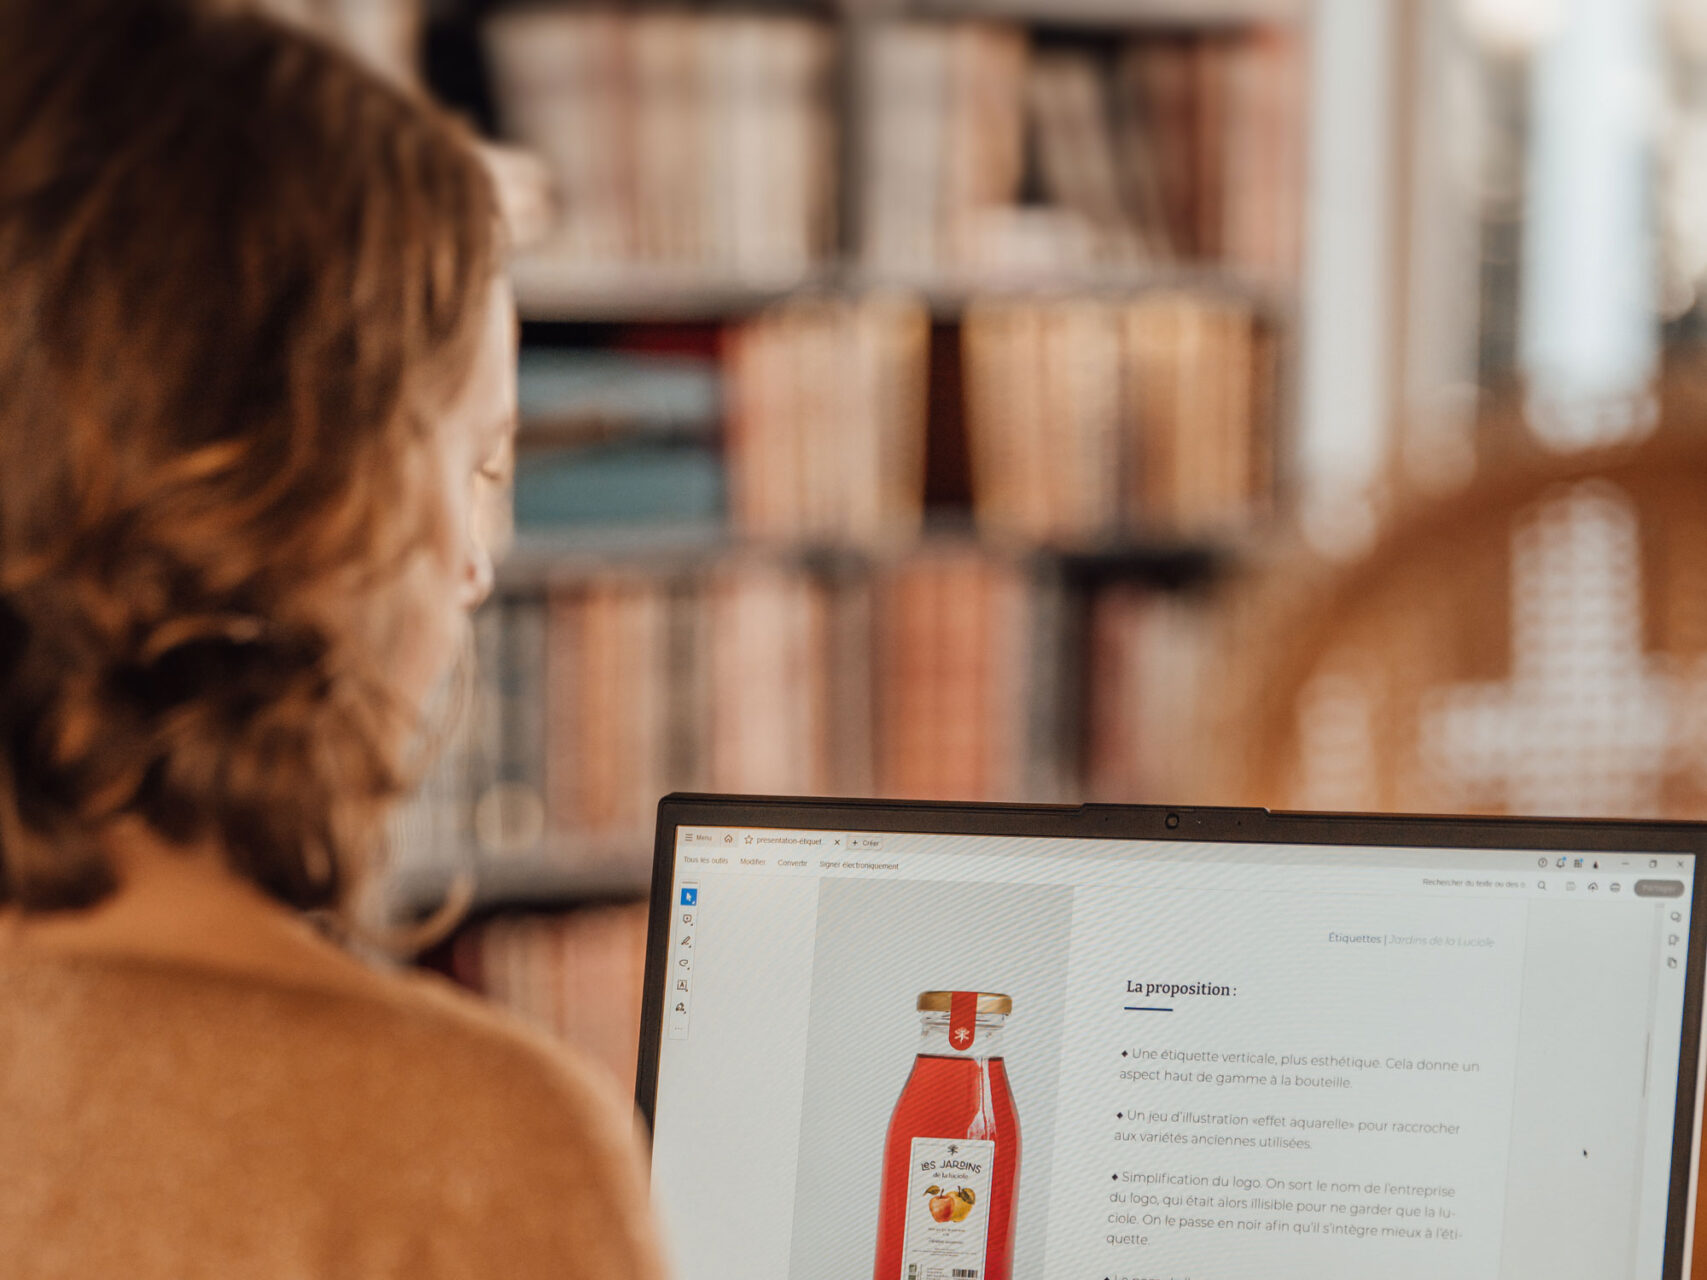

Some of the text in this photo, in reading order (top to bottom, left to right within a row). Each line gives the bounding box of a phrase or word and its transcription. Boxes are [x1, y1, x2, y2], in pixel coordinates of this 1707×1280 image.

[684, 856, 698, 864] Tous
[1422, 878, 1463, 888] Rechercher
[1328, 931, 1381, 944] Étiquettes
[1388, 934, 1427, 946] Jardins
[1429, 935, 1442, 946] de
[1445, 936, 1456, 946] la
[1457, 937, 1495, 948] Luciole
[1127, 980, 1143, 993] La
[1132, 1048, 1158, 1060] Une
[1160, 1049, 1219, 1063] étiquette
[1221, 1052, 1278, 1065] verticale,
[1281, 1054, 1308, 1068] plus
[1385, 1058, 1414, 1070] Cela
[1417, 1059, 1459, 1072] donne
[1462, 1062, 1480, 1072] un
[1119, 1069, 1352, 1089] aspect haut de gamme à la bouteille.
[1127, 1110, 1145, 1121] Un
[1147, 1111, 1168, 1124] jeu
[1171, 1111, 1249, 1126] d'illustration
[1358, 1121, 1388, 1133] pour
[1392, 1122, 1460, 1135] raccrocher
[1114, 1131, 1312, 1150] aux variétés anciennes utilisées.
[940, 1160, 982, 1174] JARDINS
[1121, 1171, 1209, 1187] Simplification
[1212, 1175, 1229, 1187] du
[1266, 1177, 1286, 1190] On
[1288, 1180, 1313, 1191] sort
[1316, 1180, 1328, 1192] le
[1330, 1183, 1361, 1193] nom
[1364, 1182, 1381, 1194] de
[1384, 1182, 1456, 1198] l'entreprise
[1109, 1192, 1126, 1203] du
[1162, 1194, 1183, 1207] qui
[1185, 1194, 1214, 1208] était
[1217, 1197, 1248, 1209] alors
[1251, 1198, 1294, 1211] illisible
[1296, 1201, 1327, 1214] pour
[1330, 1203, 1346, 1213] ne
[1350, 1204, 1392, 1217] garder
[1396, 1207, 1421, 1219] que
[1424, 1207, 1435, 1218] la
[1142, 1214, 1161, 1226] On
[1165, 1215, 1176, 1227] le
[1178, 1217, 1214, 1229] passe
[1217, 1219, 1234, 1229] en
[1237, 1218, 1261, 1230] noir
[1265, 1220, 1289, 1232] afin
[1293, 1222, 1320, 1235] qu'il
[1323, 1223, 1378, 1238] s'intègre
[1381, 1227, 1421, 1238] mieux
[1425, 1226, 1432, 1238] à
